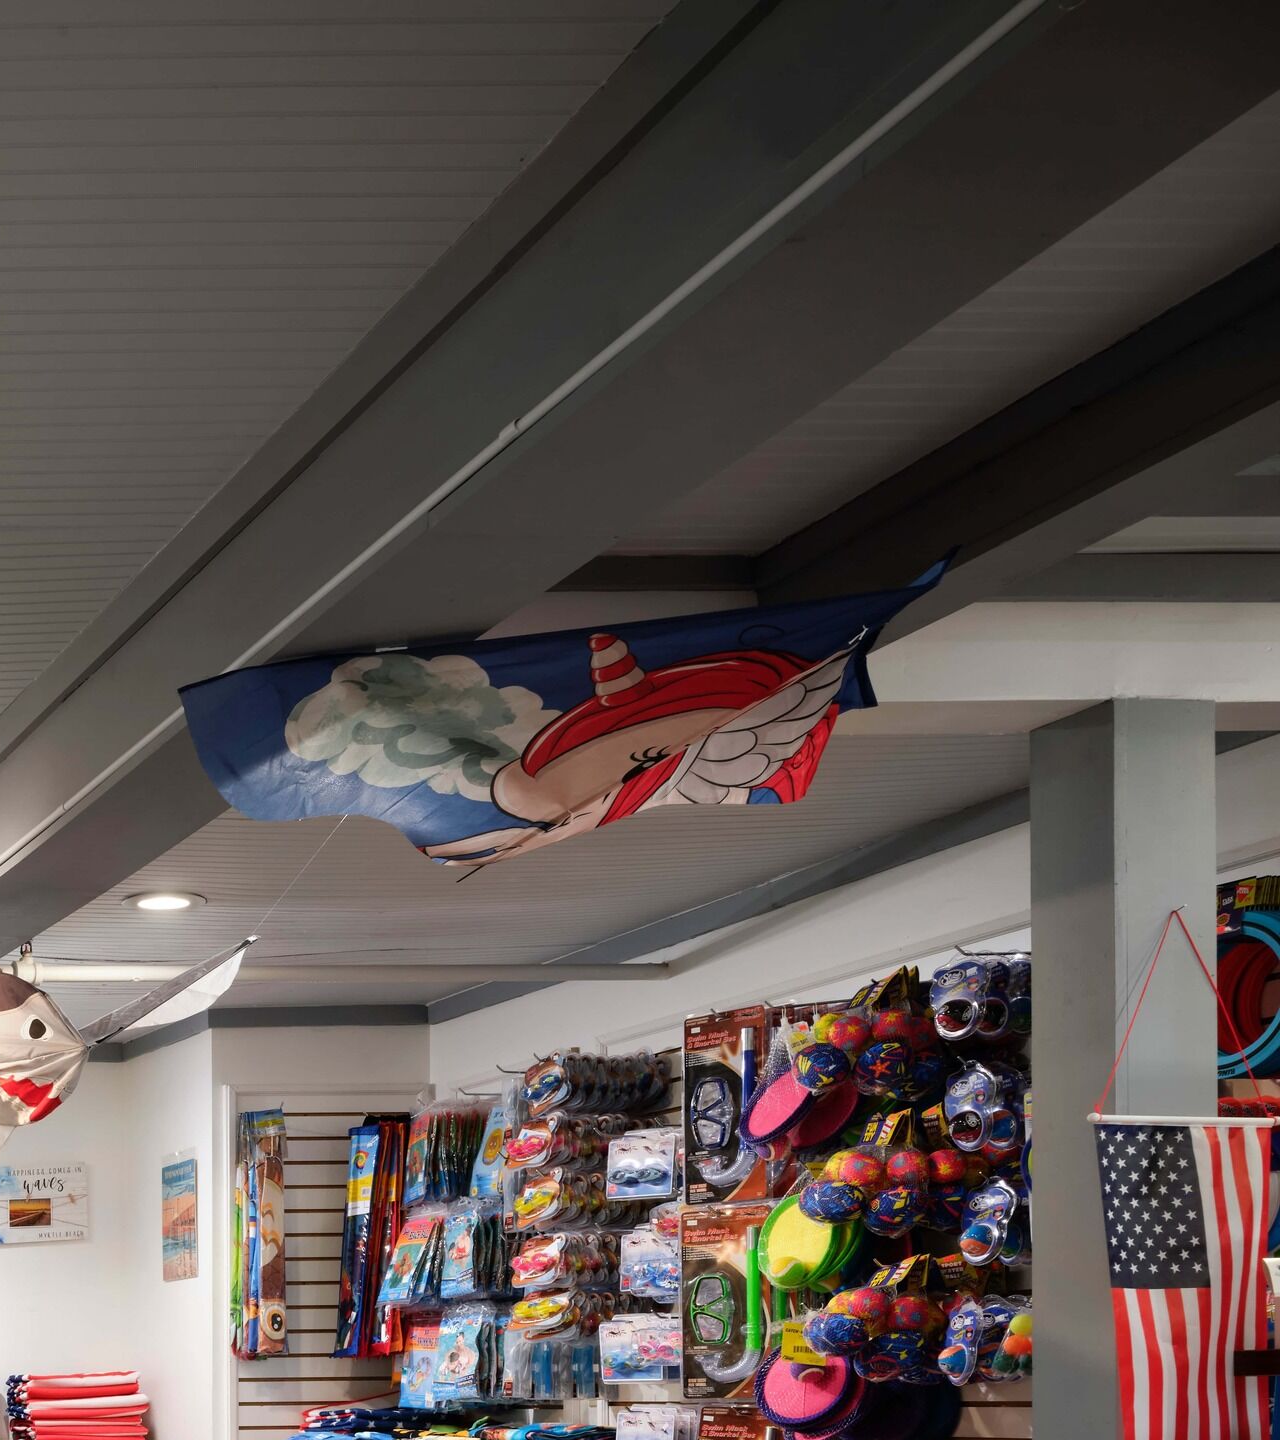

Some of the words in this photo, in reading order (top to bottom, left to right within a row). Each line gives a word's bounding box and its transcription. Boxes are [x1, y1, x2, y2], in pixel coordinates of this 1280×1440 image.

[8, 1168, 48, 1176] HAPPINESS
[48, 1167, 71, 1175] COMES
[75, 1166, 82, 1174] IN
[23, 1177, 65, 1194] waves
